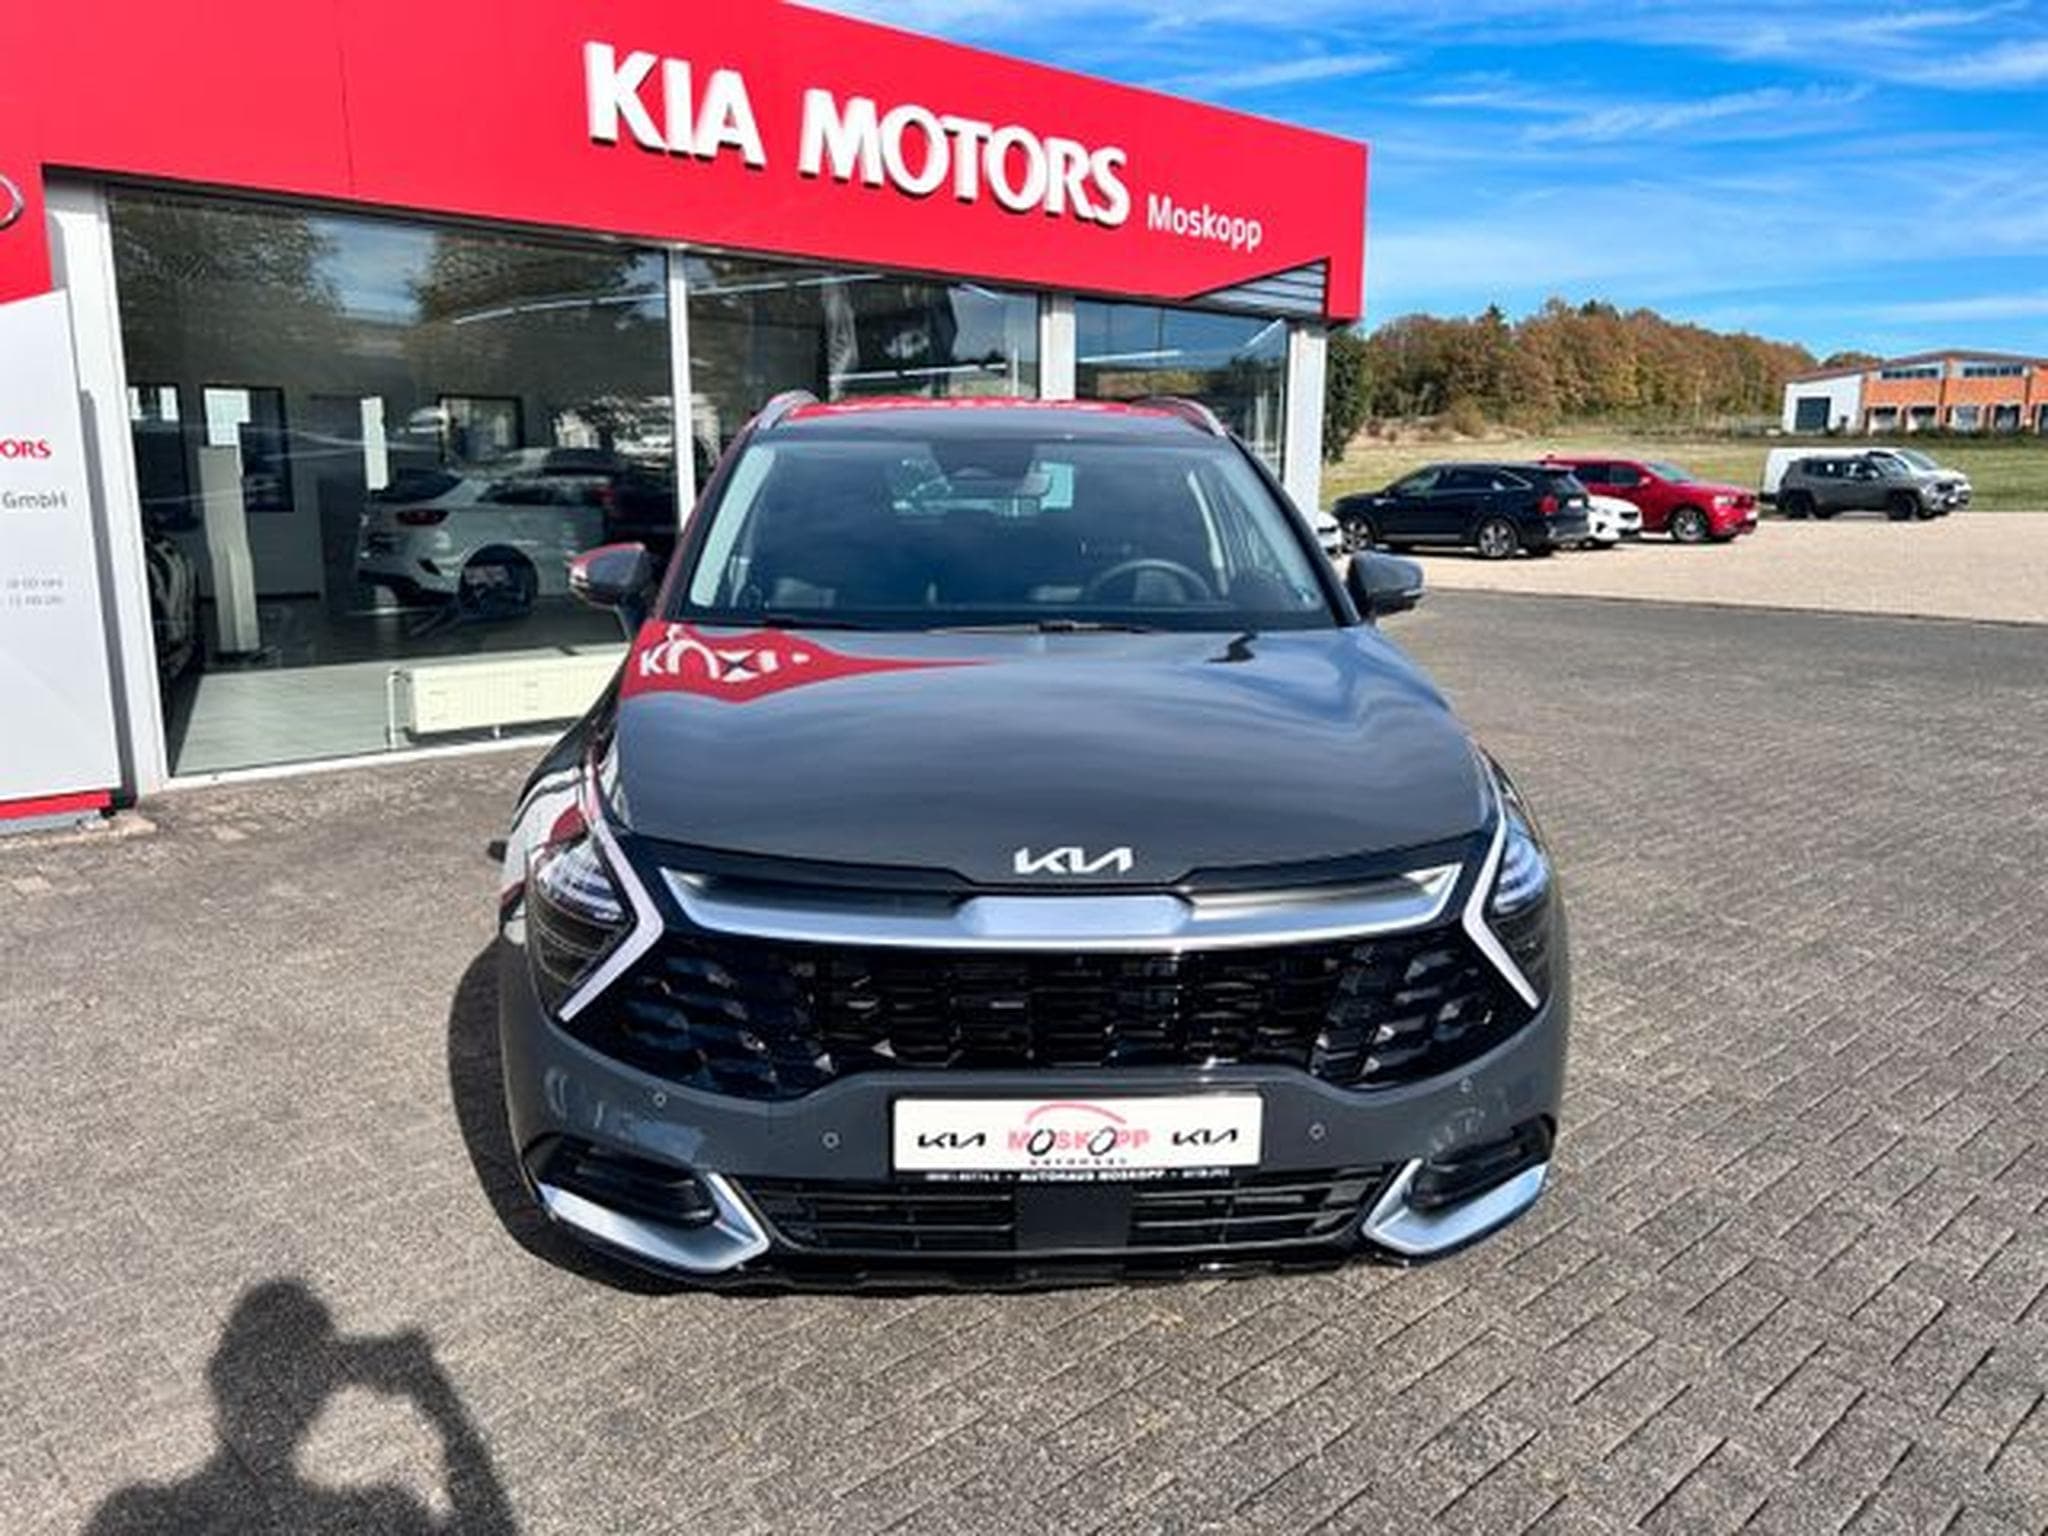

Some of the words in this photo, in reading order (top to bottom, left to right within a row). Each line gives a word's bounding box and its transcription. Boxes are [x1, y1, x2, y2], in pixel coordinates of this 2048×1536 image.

[584, 40, 766, 168] KIA
[799, 87, 1131, 228] MOTORS
[1147, 193, 1264, 250] Moskopp
[2, 491, 68, 509] GmbH
[1014, 846, 1133, 874] KIA
[917, 1132, 986, 1149] KIA
[1007, 1126, 1152, 1156] MOSKOPP
[1172, 1128, 1238, 1146] KIA
